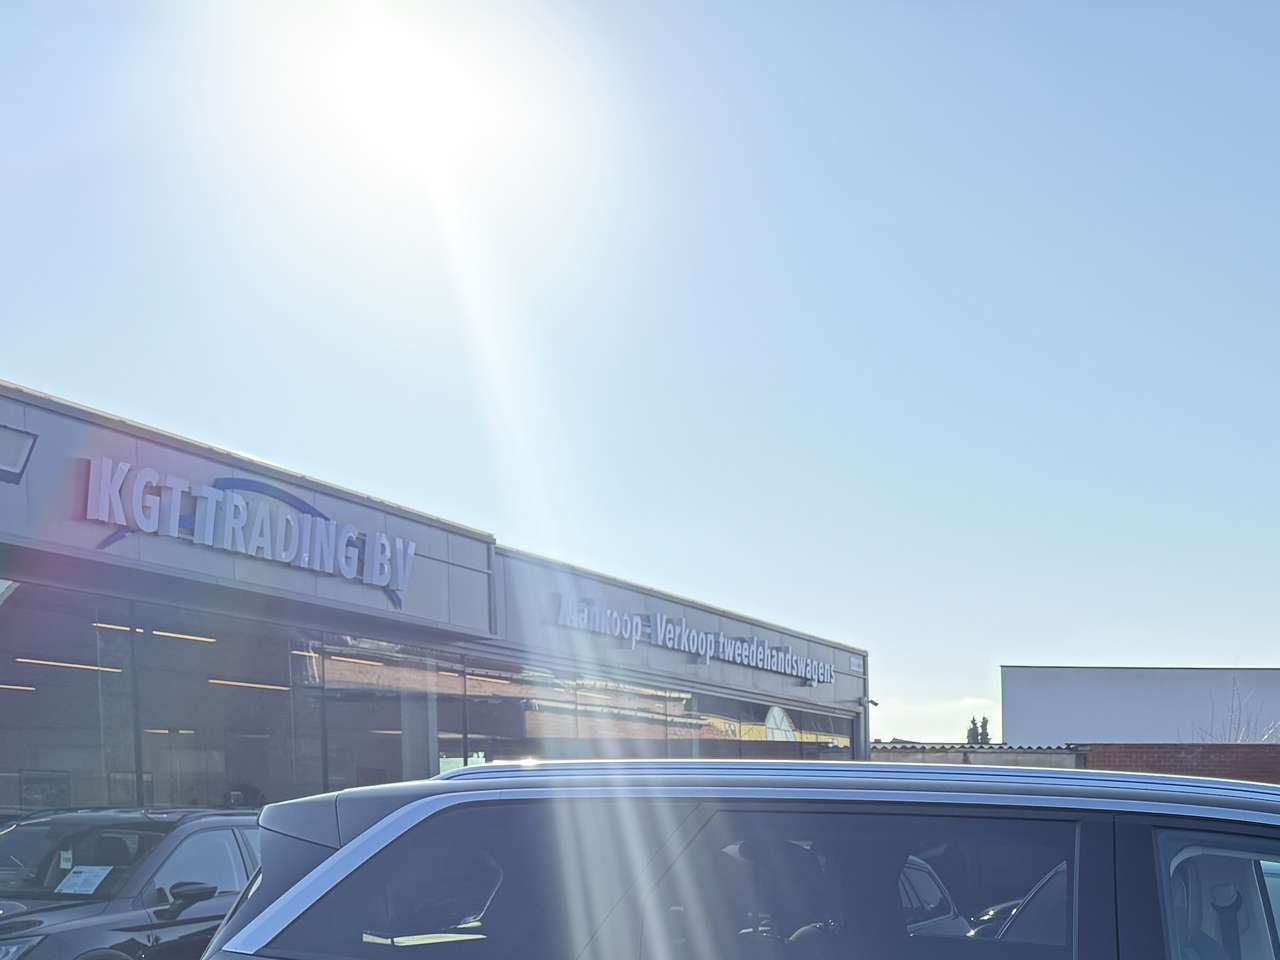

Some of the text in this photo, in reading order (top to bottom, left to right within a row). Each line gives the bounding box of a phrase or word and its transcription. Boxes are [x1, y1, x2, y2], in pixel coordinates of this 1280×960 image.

[88, 457, 416, 592] KGT TRADING BV
[656, 612, 714, 665] Verkoop
[718, 631, 836, 687] tweedehandswagens
